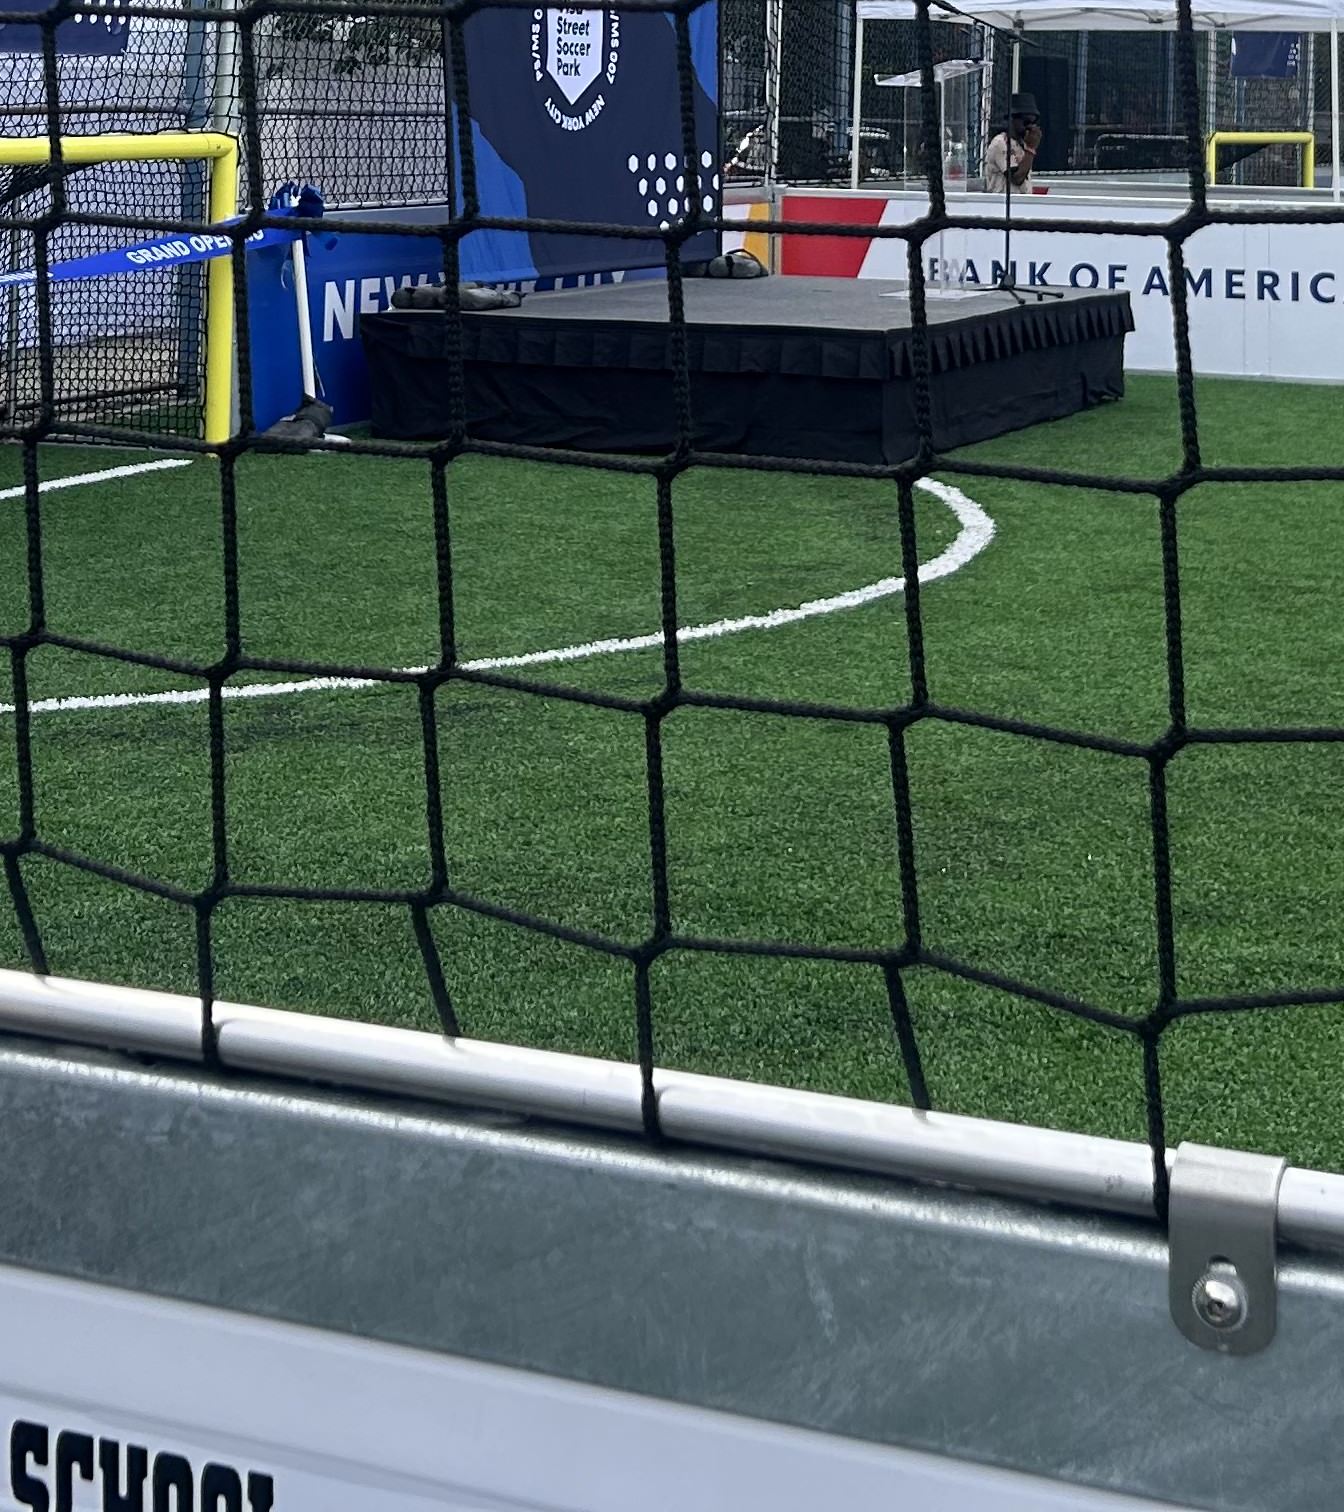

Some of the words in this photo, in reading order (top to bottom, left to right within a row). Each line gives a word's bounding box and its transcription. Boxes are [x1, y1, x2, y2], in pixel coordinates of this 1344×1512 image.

[557, 16, 590, 36] Street
[557, 37, 591, 56] Soccer
[557, 58, 581, 76] Park
[606, 51, 618, 85] 007
[544, 97, 561, 124] CITY
[585, 94, 605, 126] NEW
[126, 241, 190, 264] GRAND
[929, 257, 1052, 286] BANK
[1069, 262, 1128, 290] OF
